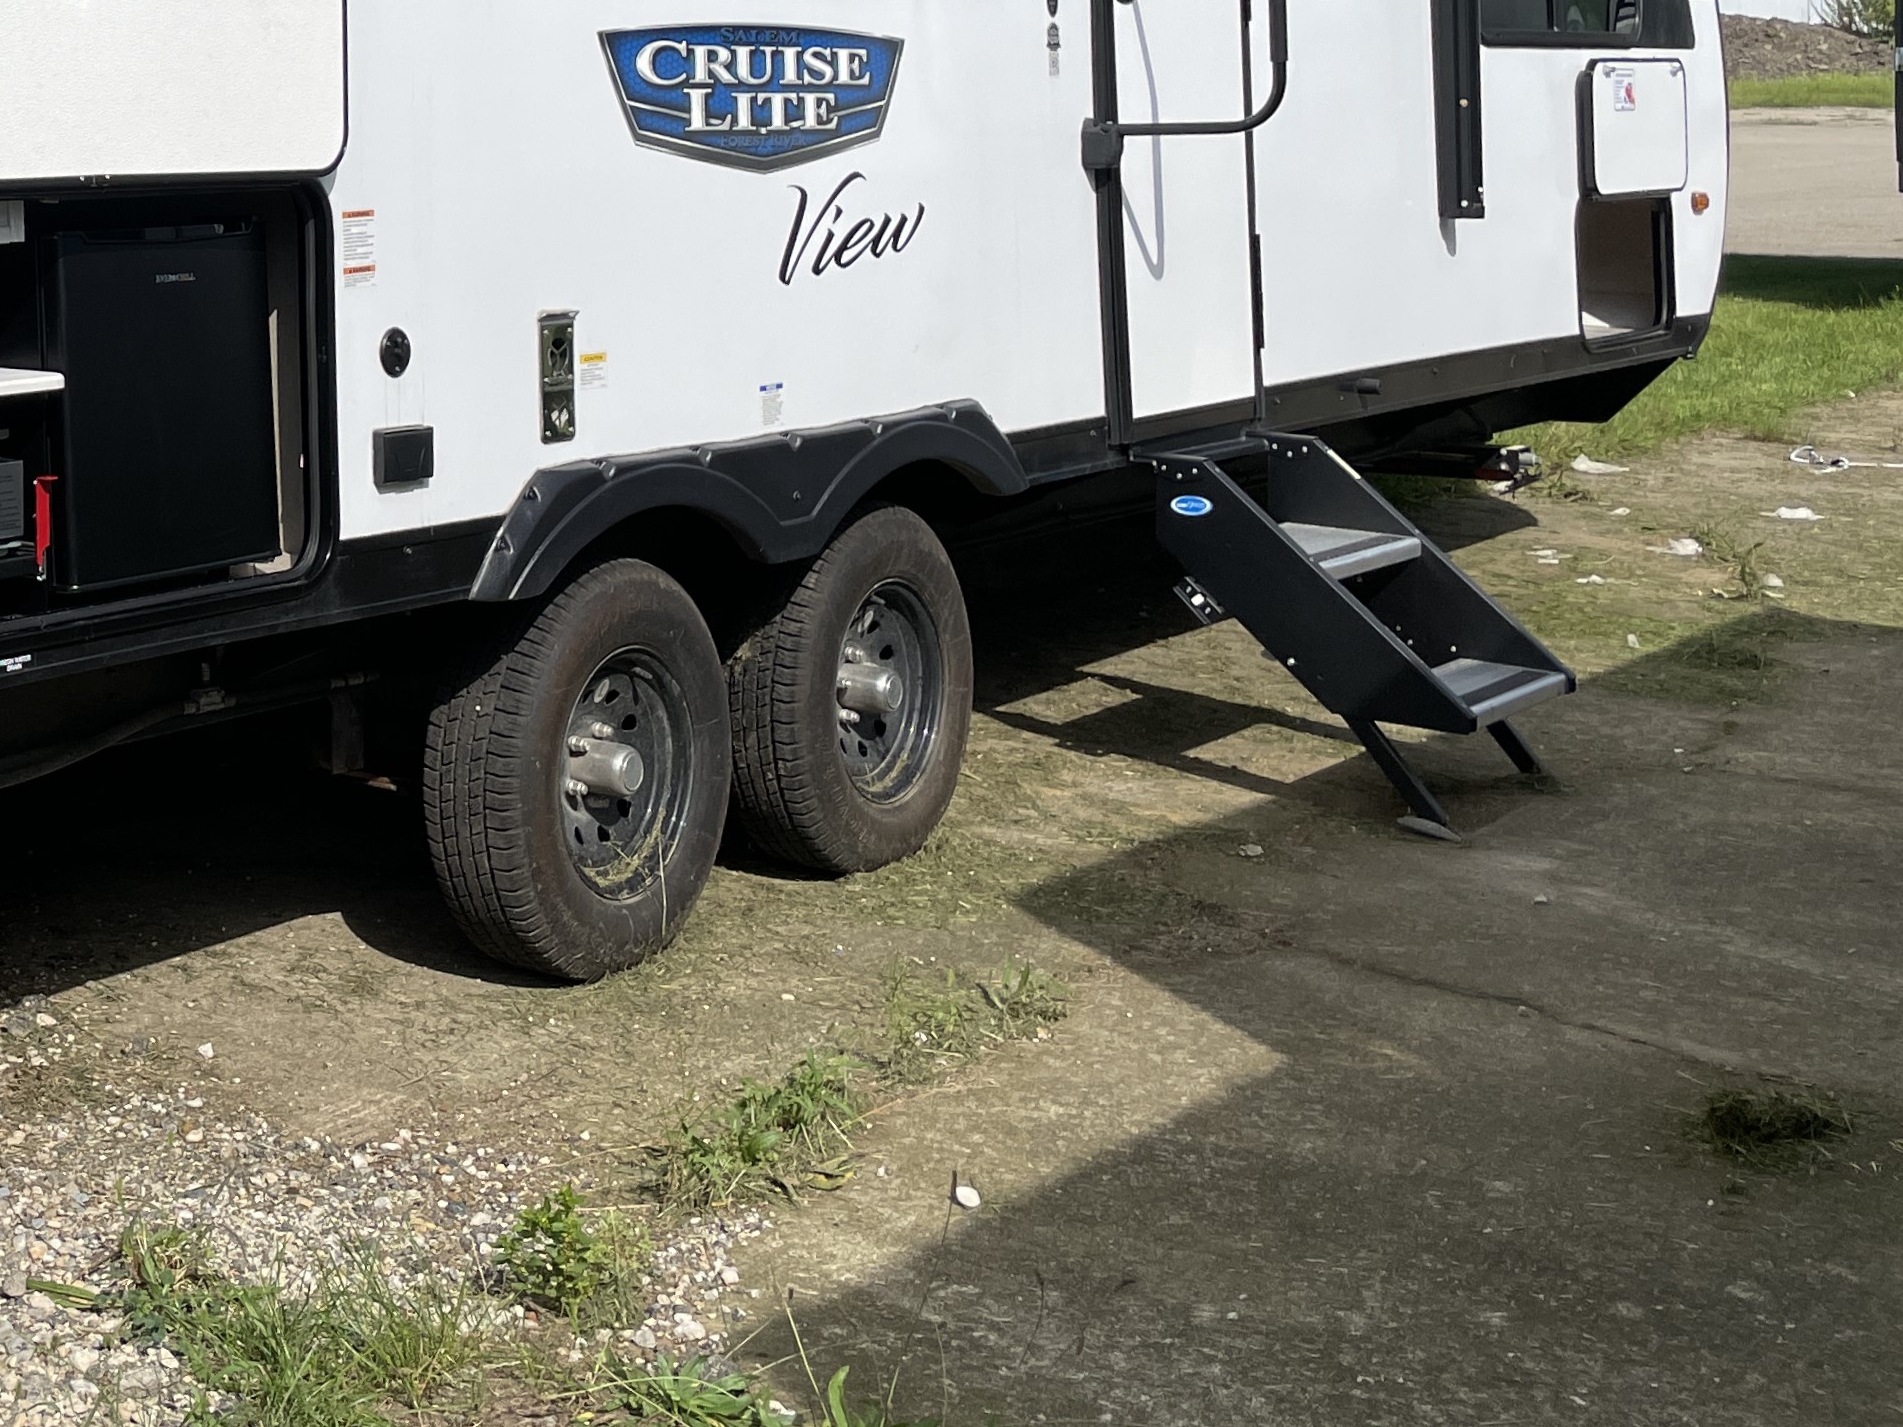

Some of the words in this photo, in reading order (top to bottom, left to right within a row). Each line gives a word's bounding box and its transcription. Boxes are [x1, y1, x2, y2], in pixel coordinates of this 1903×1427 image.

[720, 27, 800, 44] SALEM
[635, 40, 871, 85] CRUISE
[683, 87, 839, 132] LITE
[720, 134, 767, 148] FOREST
[770, 134, 808, 148] RIVER
[778, 171, 925, 286] View
